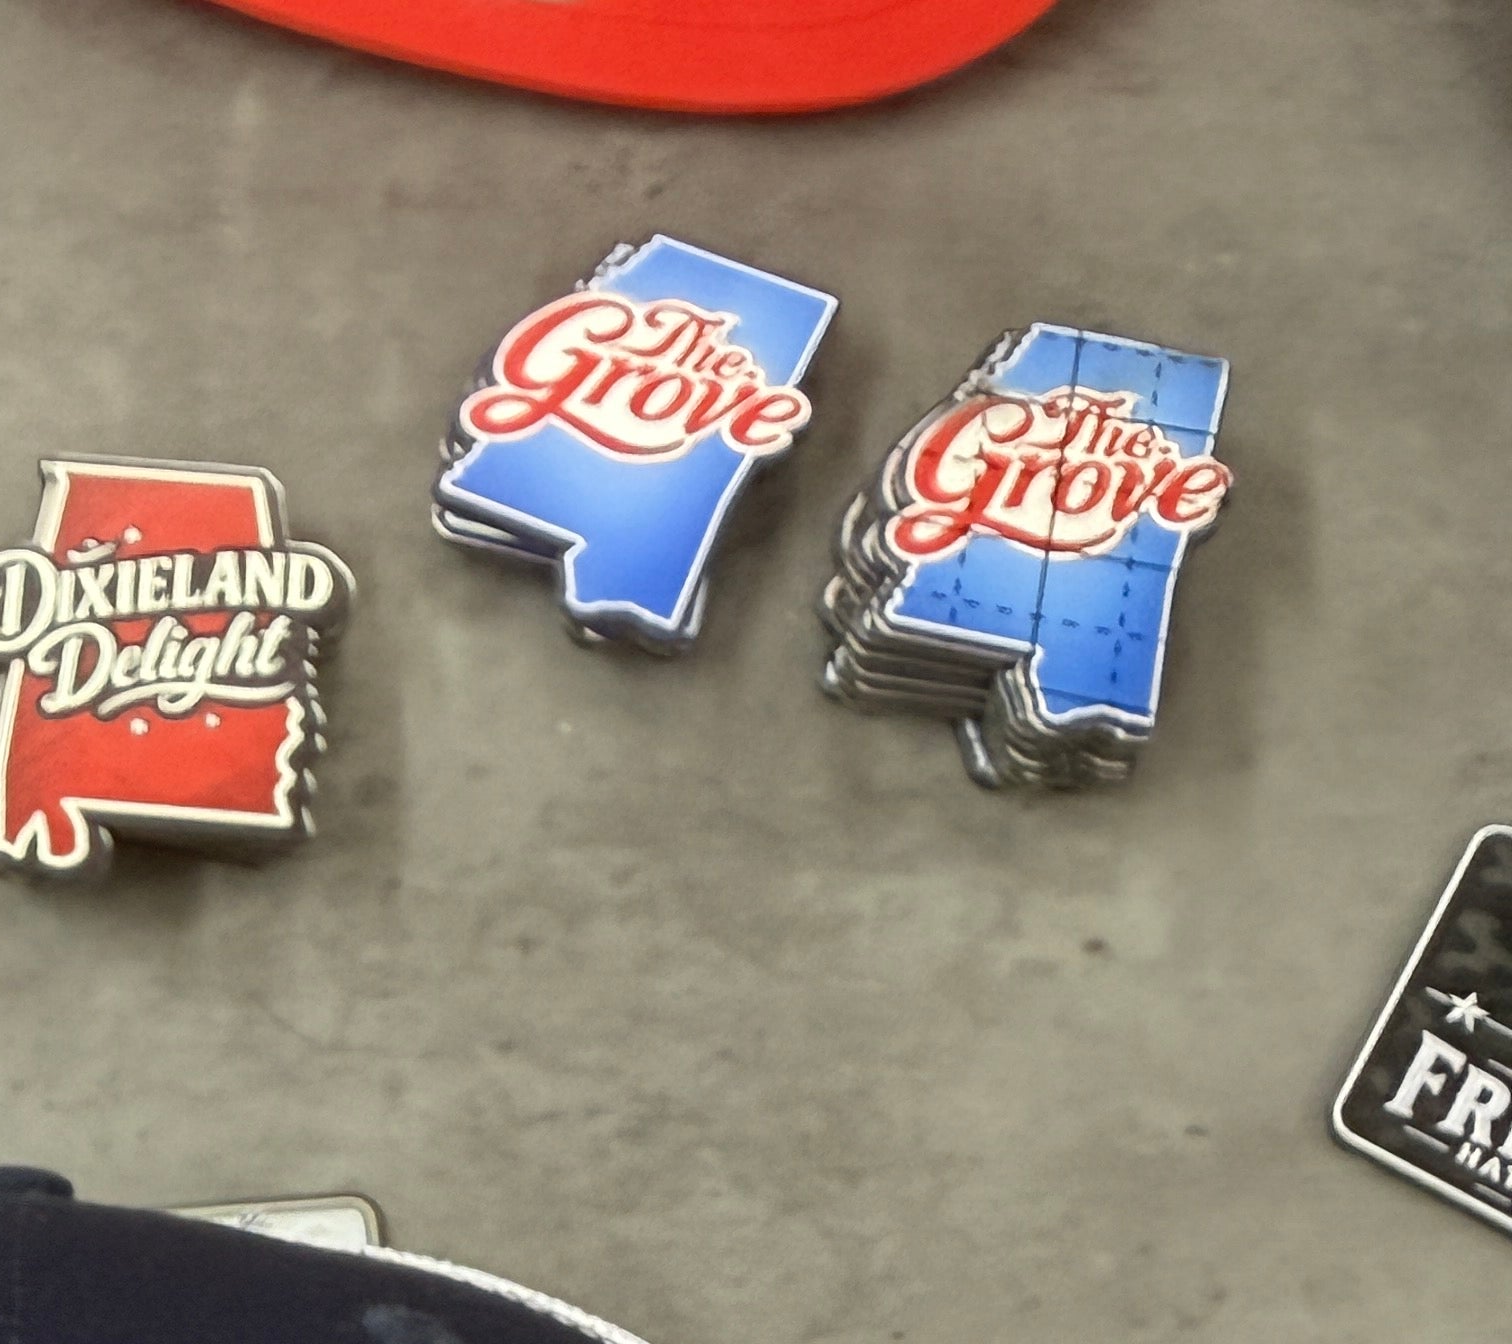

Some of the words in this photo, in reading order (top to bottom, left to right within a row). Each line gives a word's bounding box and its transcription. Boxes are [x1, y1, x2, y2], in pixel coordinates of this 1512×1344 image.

[470, 298, 802, 455] Grove
[636, 304, 758, 378] The
[894, 398, 1230, 555] Grove
[1026, 397, 1172, 458] The
[28, 610, 296, 717] Delight
[1382, 1029, 1512, 1160] FR
